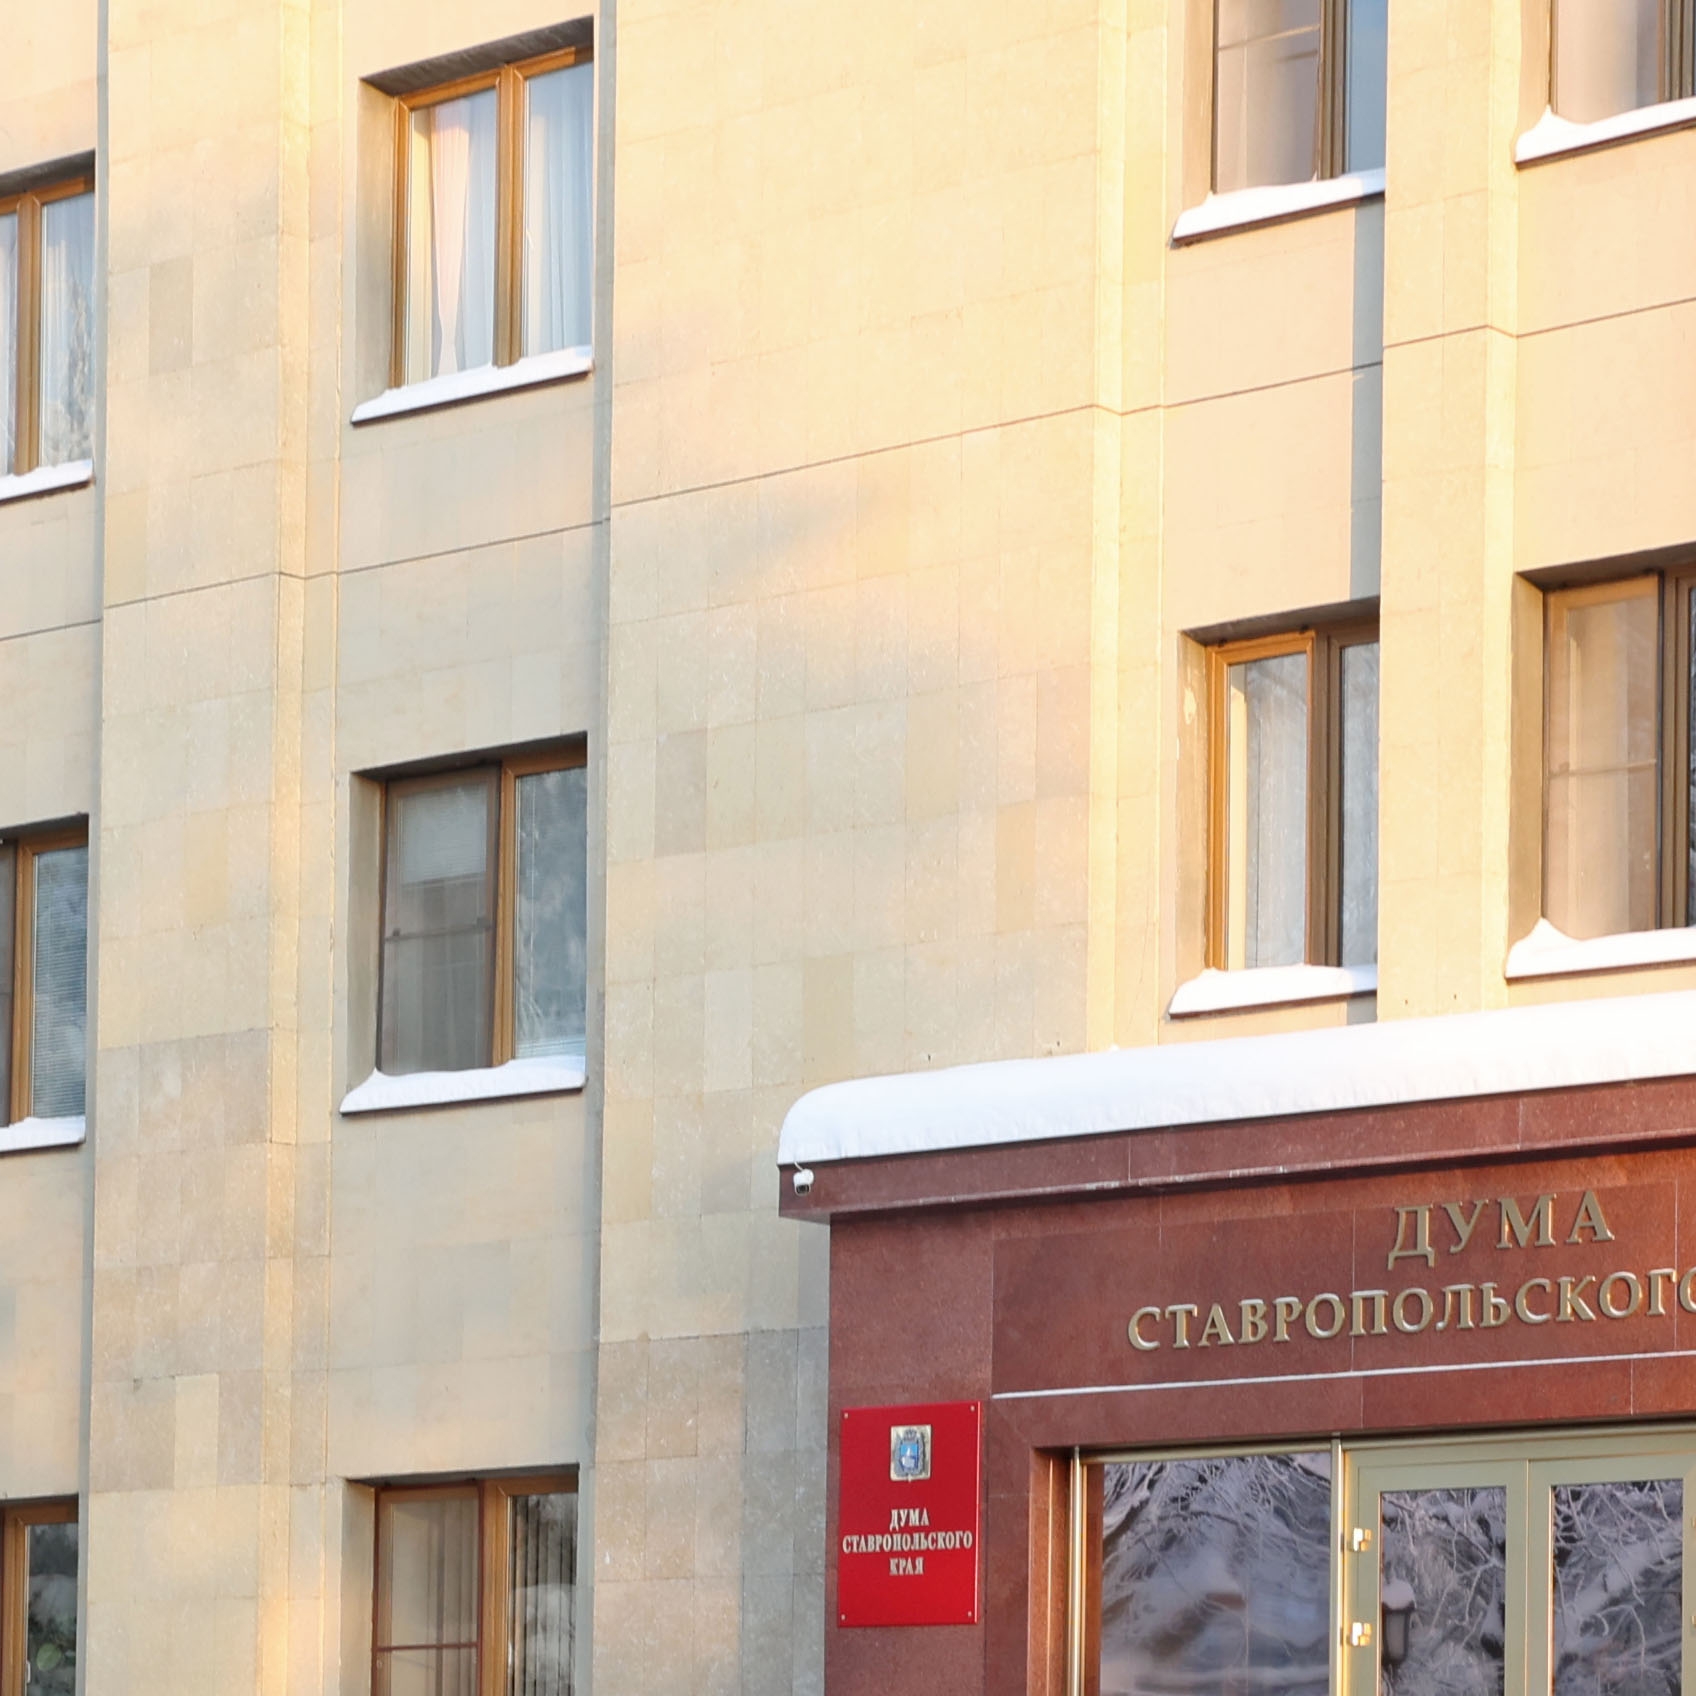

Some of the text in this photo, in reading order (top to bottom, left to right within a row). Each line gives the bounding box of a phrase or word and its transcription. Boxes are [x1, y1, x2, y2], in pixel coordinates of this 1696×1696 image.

[1388, 1191, 1615, 1269] ДУМА
[889, 1508, 929, 1530] ДУМА
[842, 1530, 973, 1553] СТАВРОПОЛЬСКОГО
[889, 1557, 924, 1575] КРАЯ
